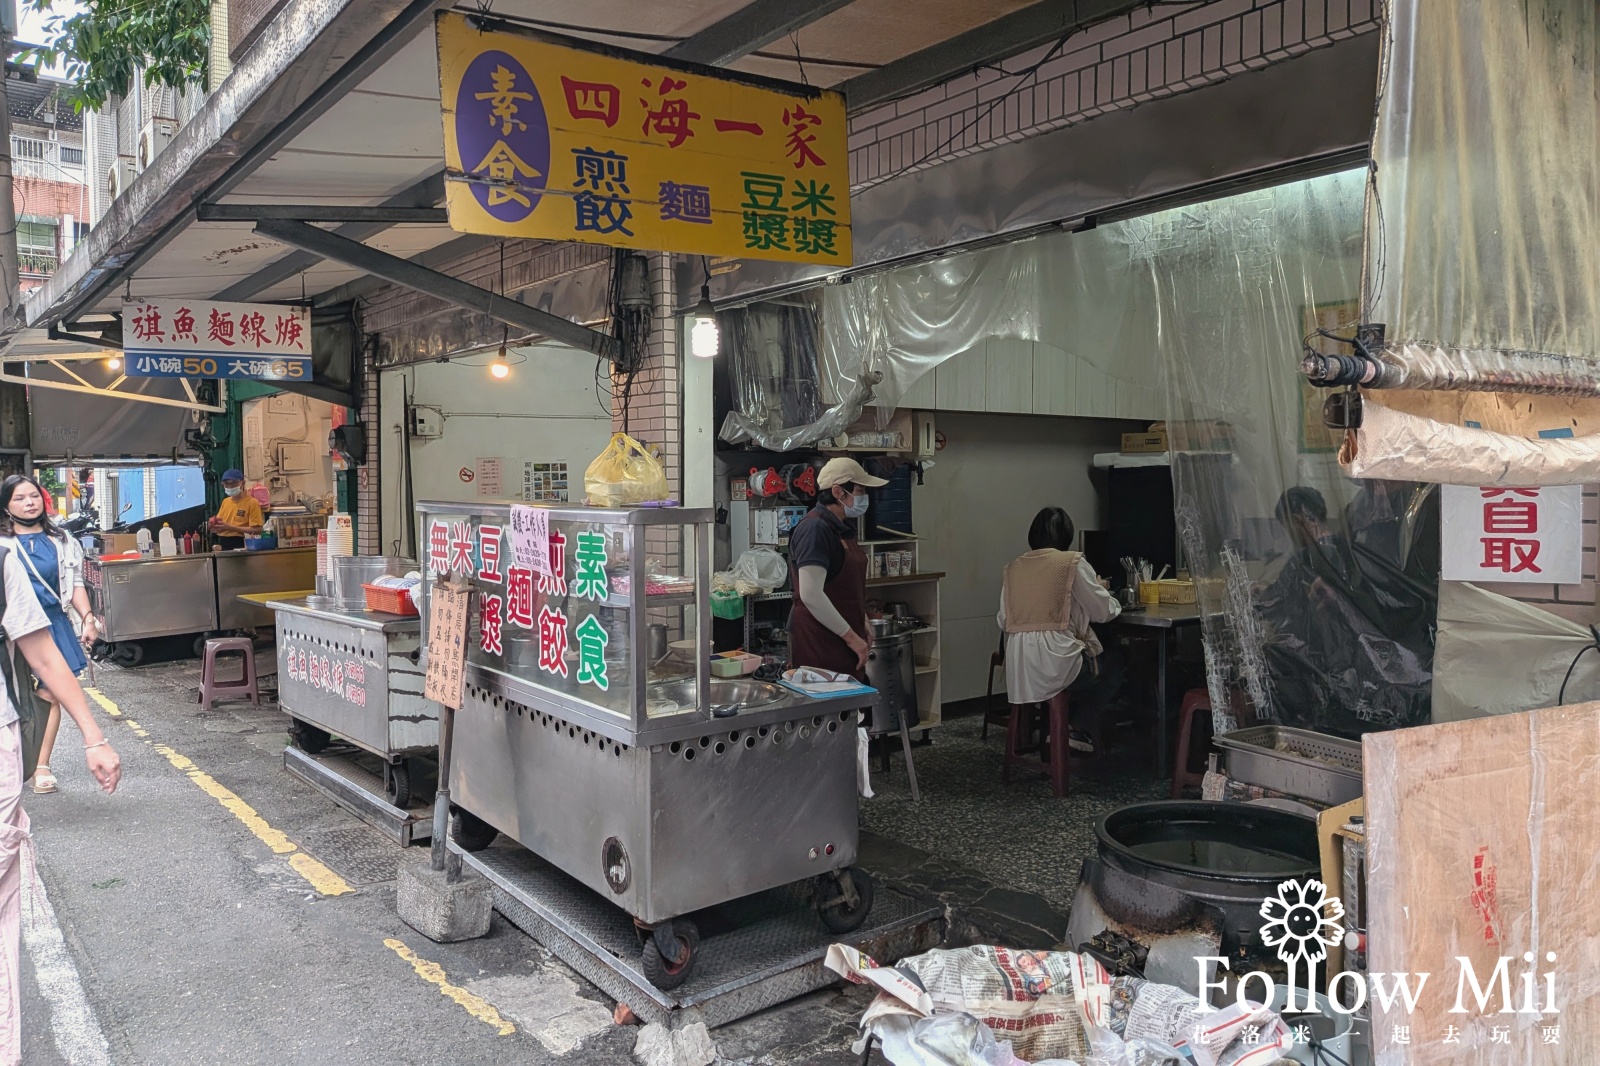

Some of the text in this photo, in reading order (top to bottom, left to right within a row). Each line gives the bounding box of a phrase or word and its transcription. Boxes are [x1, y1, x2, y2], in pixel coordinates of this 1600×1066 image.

[474, 64, 542, 209] 素食
[561, 75, 827, 169] 四海一家
[571, 147, 634, 237] 煎餃
[659, 181, 713, 224] 麵
[741, 171, 790, 251] 豆漿
[791, 179, 838, 256] 米漿
[132, 304, 303, 350] 旗魚麵線焿
[136, 356, 304, 378] 小碗50 大碗65
[479, 526, 502, 654] 豆漿
[508, 566, 533, 626] 麵
[576, 531, 608, 689] 素食
